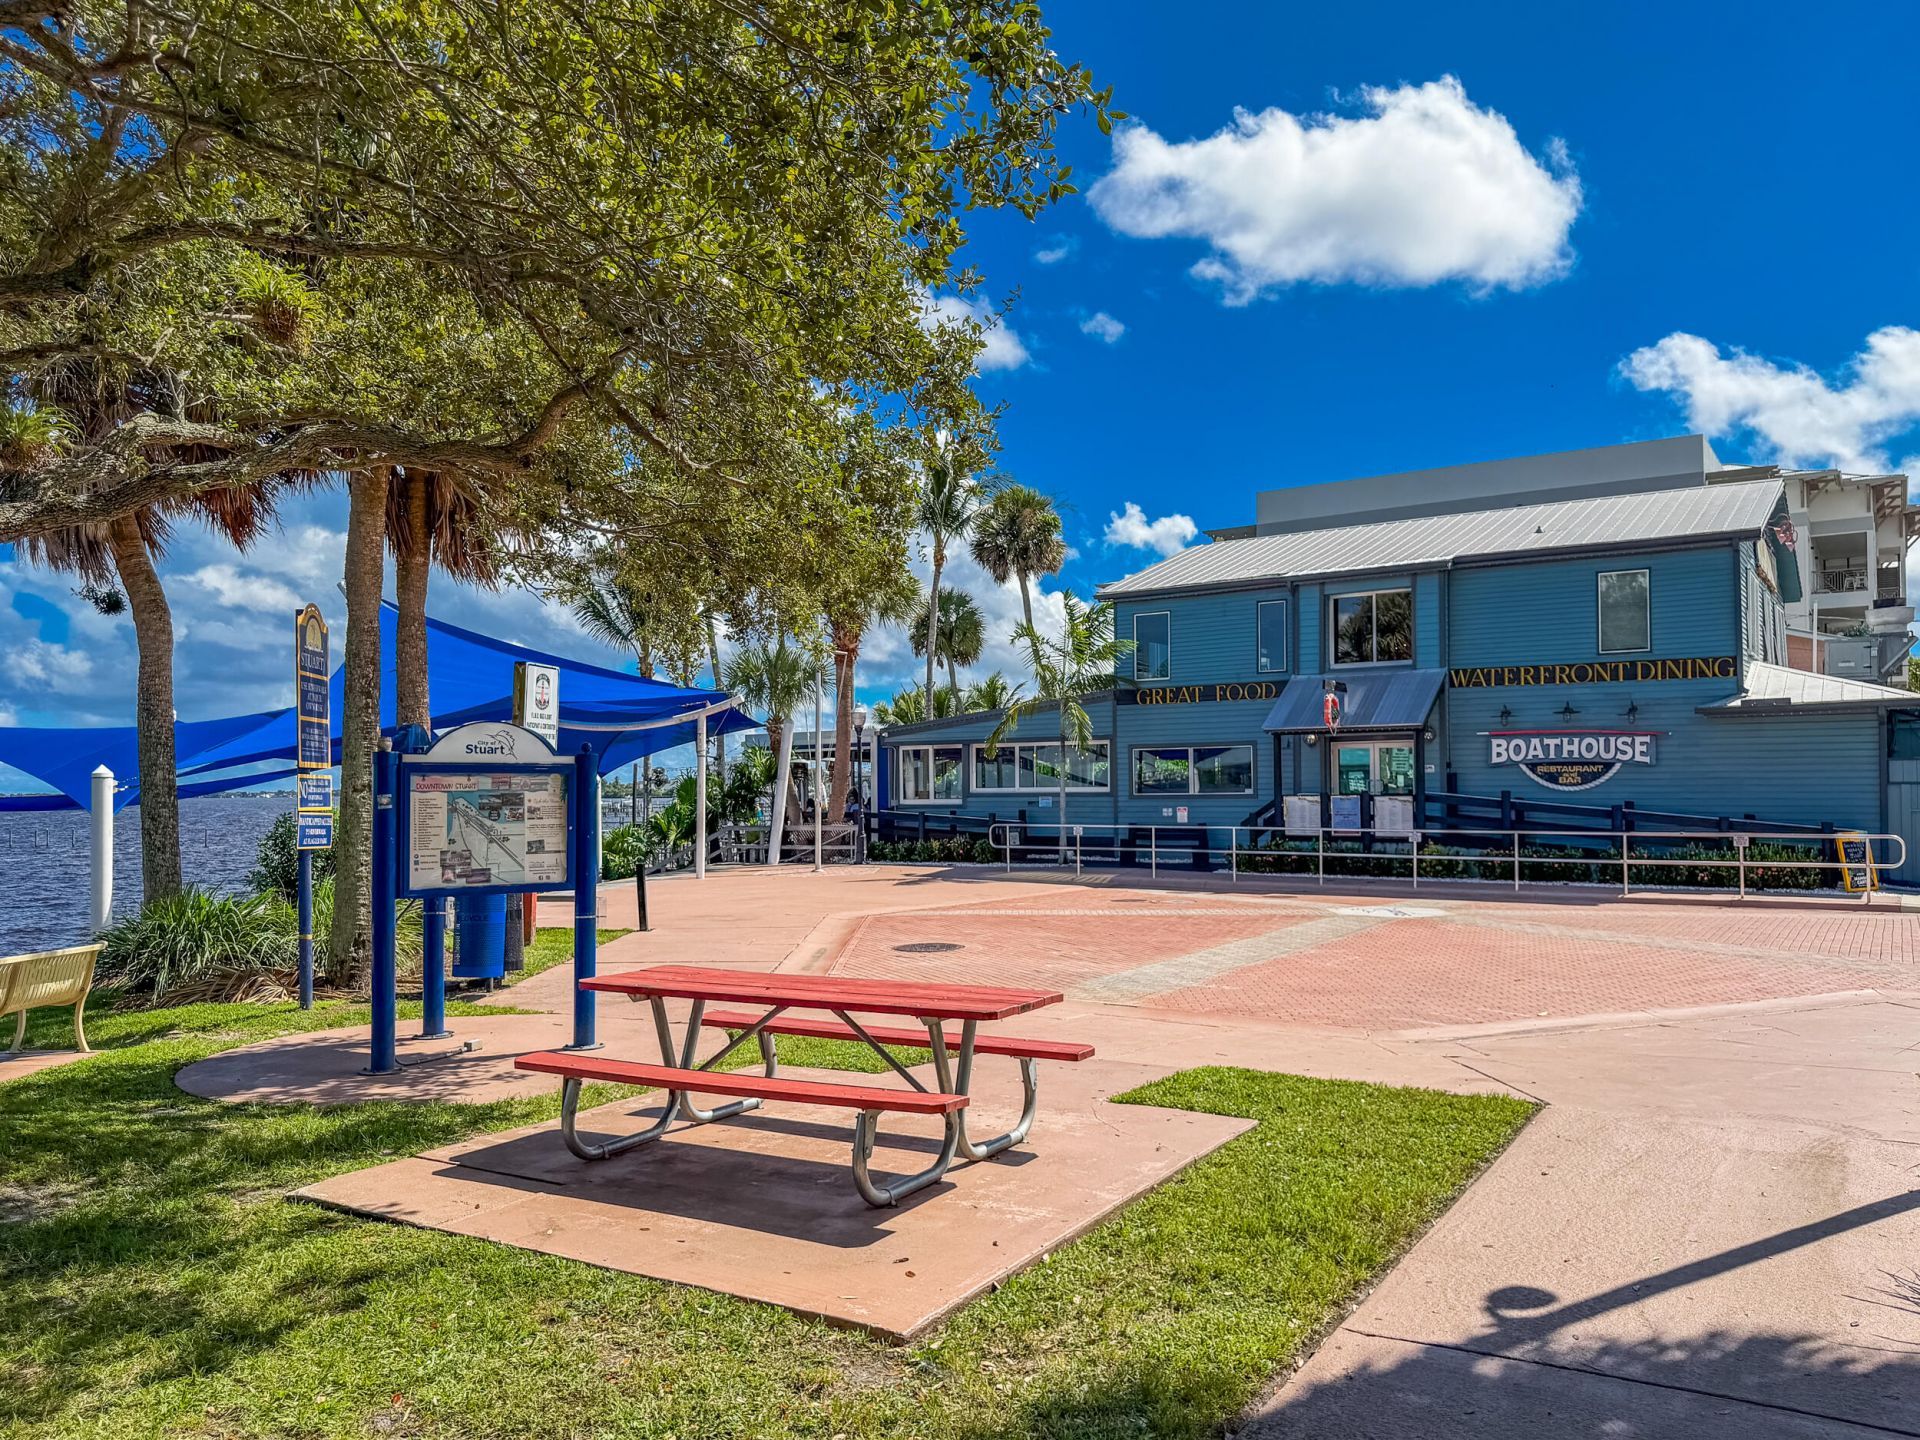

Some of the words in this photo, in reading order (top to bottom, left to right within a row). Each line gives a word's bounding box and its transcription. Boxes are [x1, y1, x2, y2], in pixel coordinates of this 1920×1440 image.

[301, 652, 324, 671] STUART
[1450, 662, 1630, 688] WATERFRONT
[1636, 657, 1735, 681] DINING
[1136, 686, 1204, 705] GREAT
[1215, 682, 1276, 703] FOOD
[465, 744, 506, 755] Stuart
[1490, 734, 1650, 764] BOATHOUSE
[1537, 764, 1604, 774] RESTAURANT
